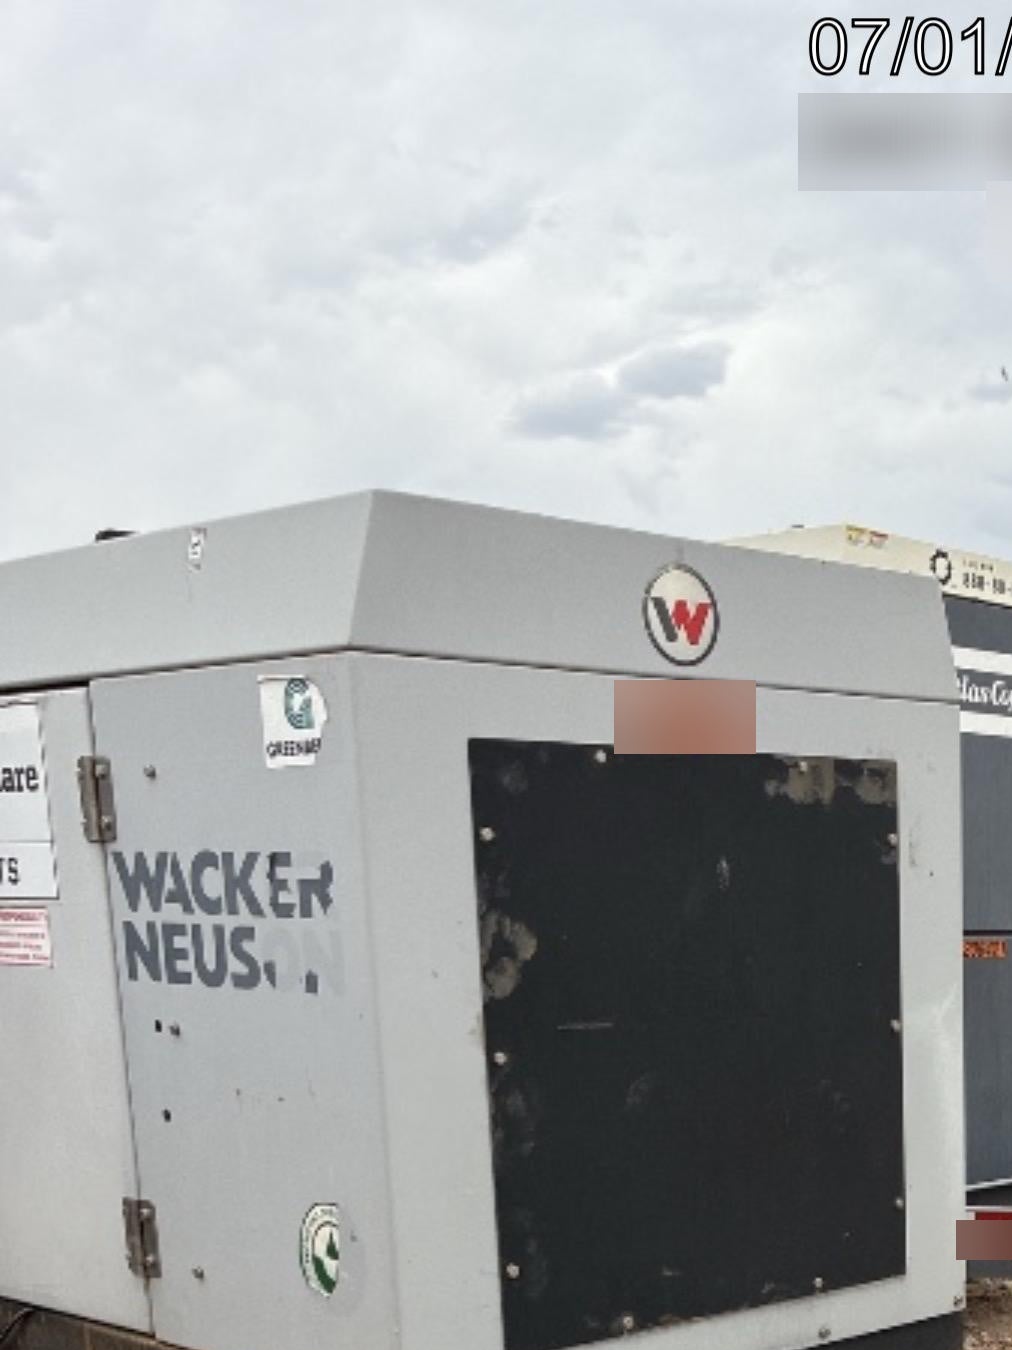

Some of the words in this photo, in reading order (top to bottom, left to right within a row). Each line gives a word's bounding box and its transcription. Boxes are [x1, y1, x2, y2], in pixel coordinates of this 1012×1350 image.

[0, 765, 39, 793] are
[111, 850, 334, 918] WACKER
[122, 921, 318, 994] NEUS
